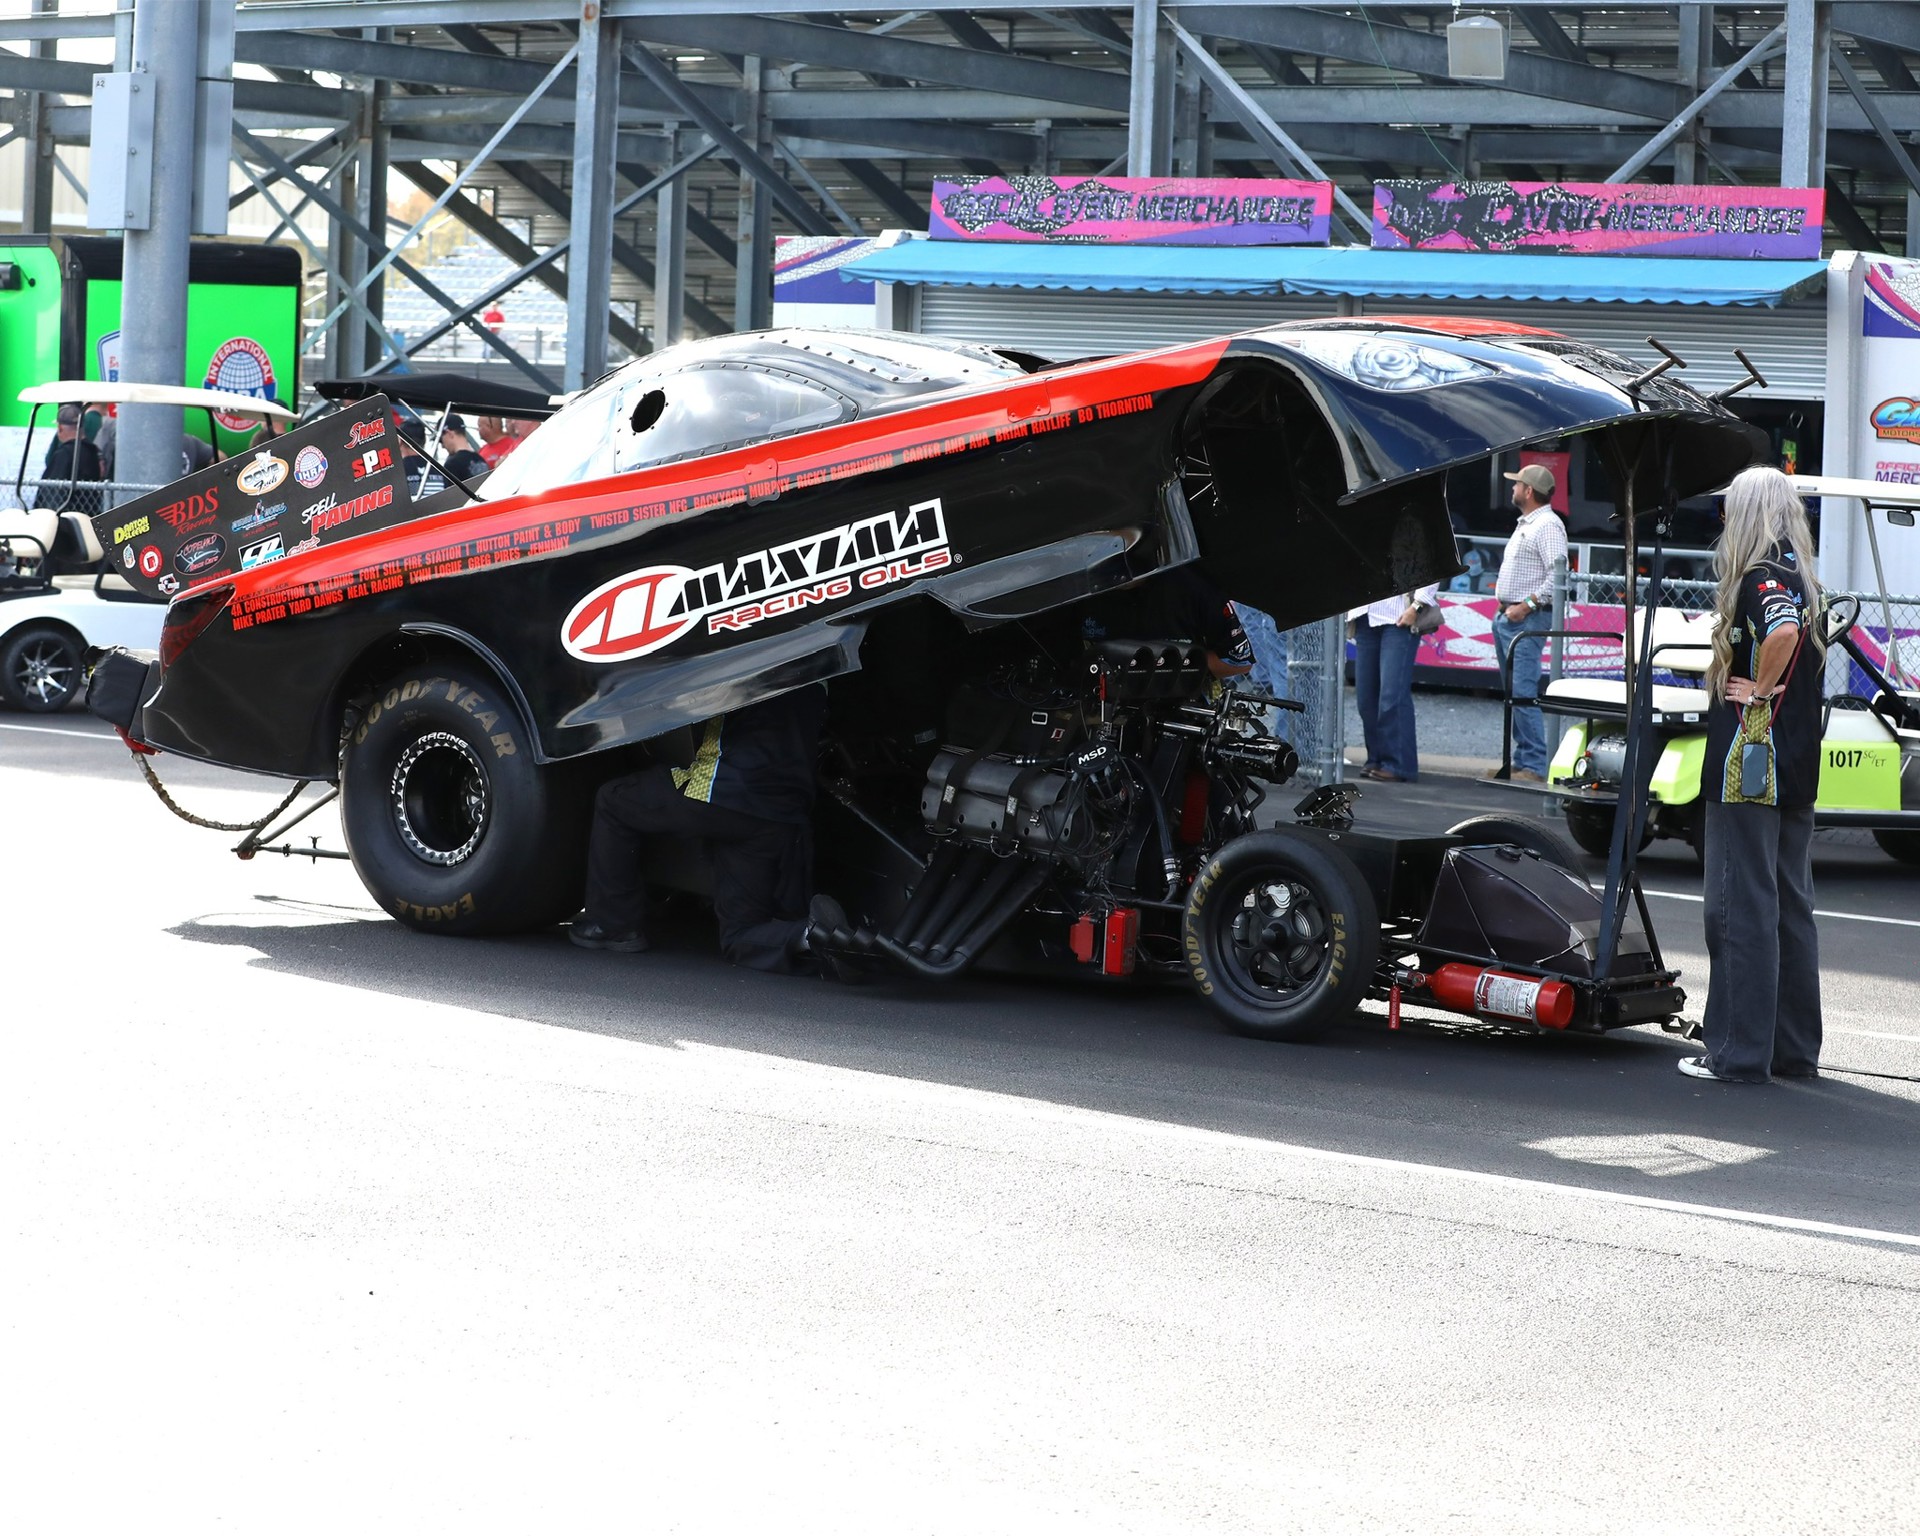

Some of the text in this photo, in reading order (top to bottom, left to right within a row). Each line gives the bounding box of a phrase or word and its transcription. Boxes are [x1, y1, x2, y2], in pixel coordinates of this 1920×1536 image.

[1052, 192, 1132, 222] EVENT
[1134, 194, 1316, 226] MERCHANDISE
[1605, 203, 1807, 236] MERCHANDISE
[209, 339, 274, 381] INTERNATIONAL
[244, 463, 280, 487] DOVE
[298, 463, 325, 481] IHRA
[352, 448, 392, 478] SPR
[166, 486, 219, 527] BDS
[231, 603, 242, 617] 4A
[244, 586, 306, 615] CONSTRUCTION
[308, 583, 316, 594] &
[318, 571, 354, 593] WELDING
[359, 564, 380, 581] FORT
[382, 559, 401, 576] SILL
[404, 556, 422, 571] FIRE
[425, 547, 462, 566] STATION
[476, 534, 511, 553] HUTTON
[513, 527, 540, 548] PAINT
[543, 525, 552, 538] &
[555, 518, 581, 535] BODY
[590, 510, 630, 529] TWISTED
[632, 503, 666, 521] SISTER
[669, 498, 688, 513] NFC
[693, 488, 747, 509] BACKYARD
[830, 453, 894, 481] BARRINGTON
[902, 441, 941, 463] CARTER
[944, 437, 965, 455] AND
[969, 433, 990, 449] AVA
[995, 424, 1028, 442] BRIAN
[1031, 414, 1072, 434] RATLIFF
[1077, 408, 1093, 424] BO
[1096, 395, 1154, 419] THORNTON
[301, 492, 338, 524] SPELL
[311, 485, 393, 536] PAVING
[232, 616, 254, 631] MIKE
[256, 606, 286, 625] PRATER
[288, 599, 312, 616] YARD
[314, 591, 344, 609] DAWGS
[347, 584, 369, 599] NEAL
[370, 574, 404, 595] RACING
[409, 570, 433, 585] LYNN
[434, 560, 463, 576] LOGUE
[468, 554, 491, 571] GREG
[494, 547, 521, 562] PIRES
[710, 550, 950, 632] RACING OILS
[391, 731, 469, 795] WELD RACING
[1078, 746, 1107, 765] MSD
[1829, 750, 1862, 768] 1017
[395, 892, 477, 922] EAGLE
[1327, 913, 1347, 988] EAGLE
